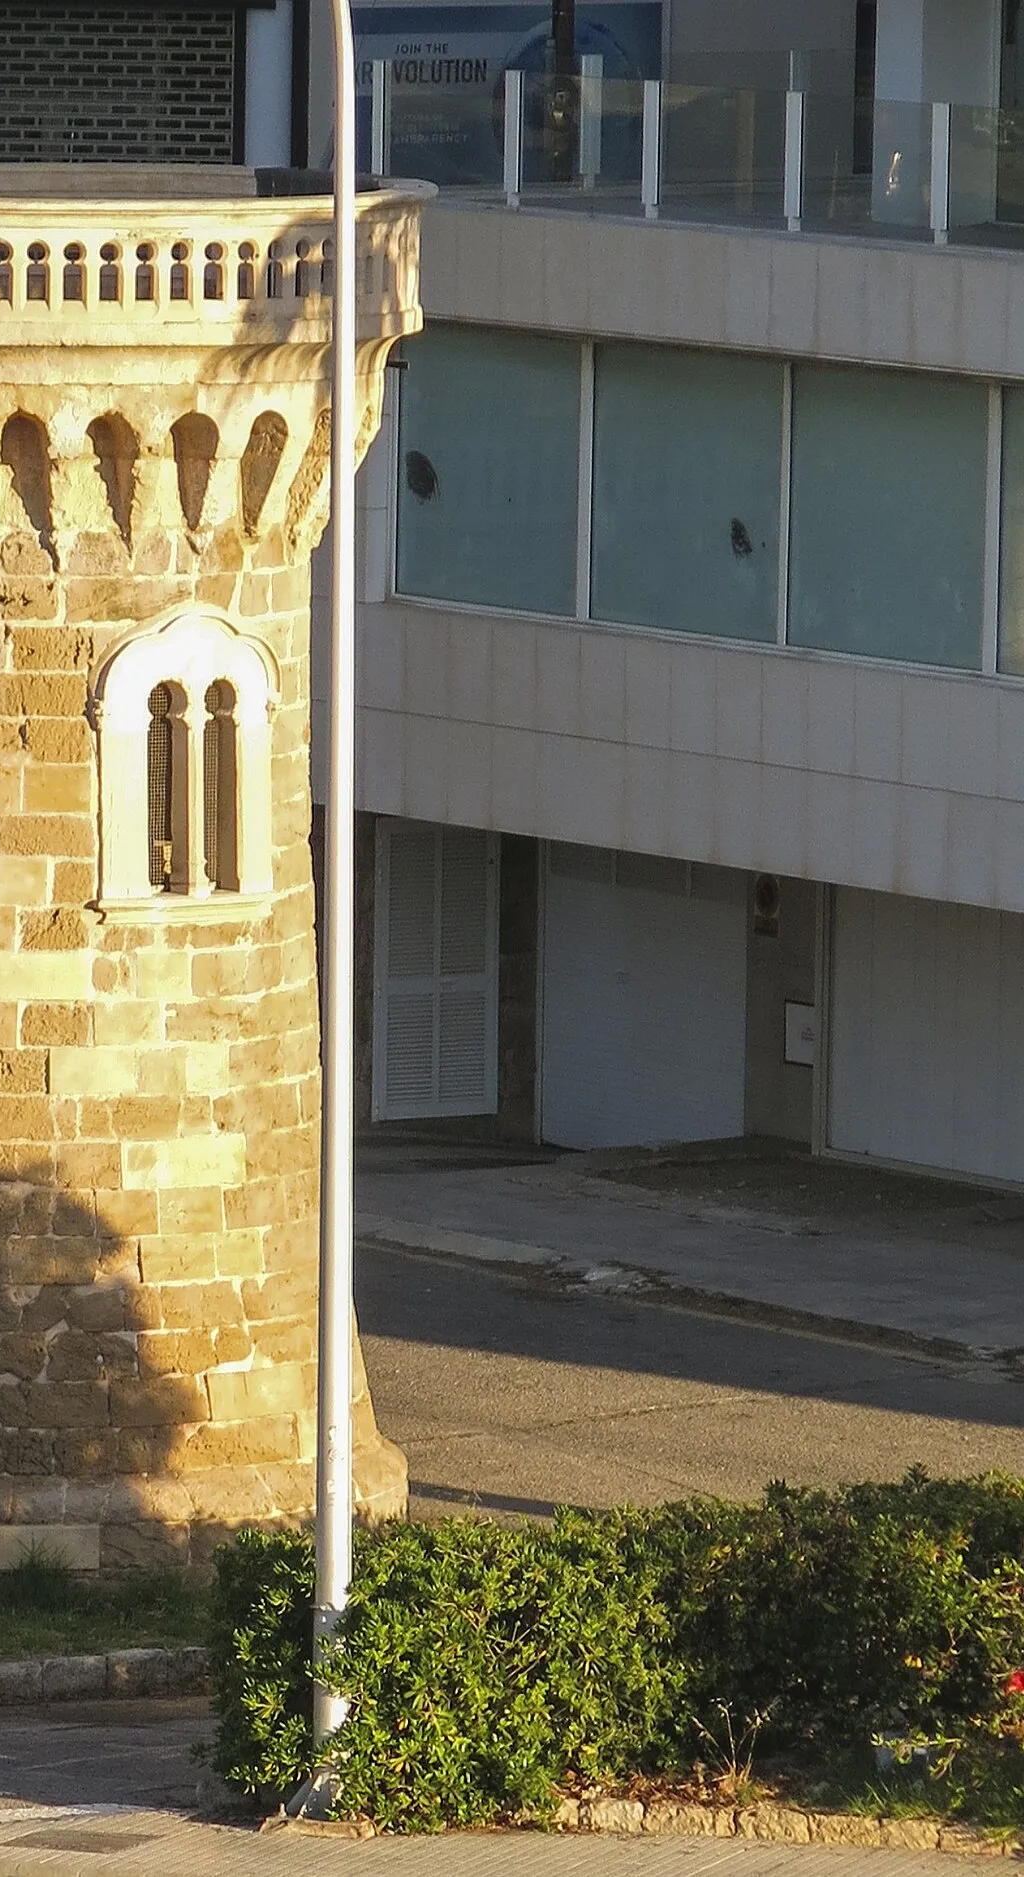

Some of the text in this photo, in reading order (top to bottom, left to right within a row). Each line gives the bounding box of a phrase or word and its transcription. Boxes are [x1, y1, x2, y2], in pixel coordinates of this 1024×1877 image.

[395, 43, 449, 54] JOIN THE
[361, 59, 488, 85] RVOLUTION
